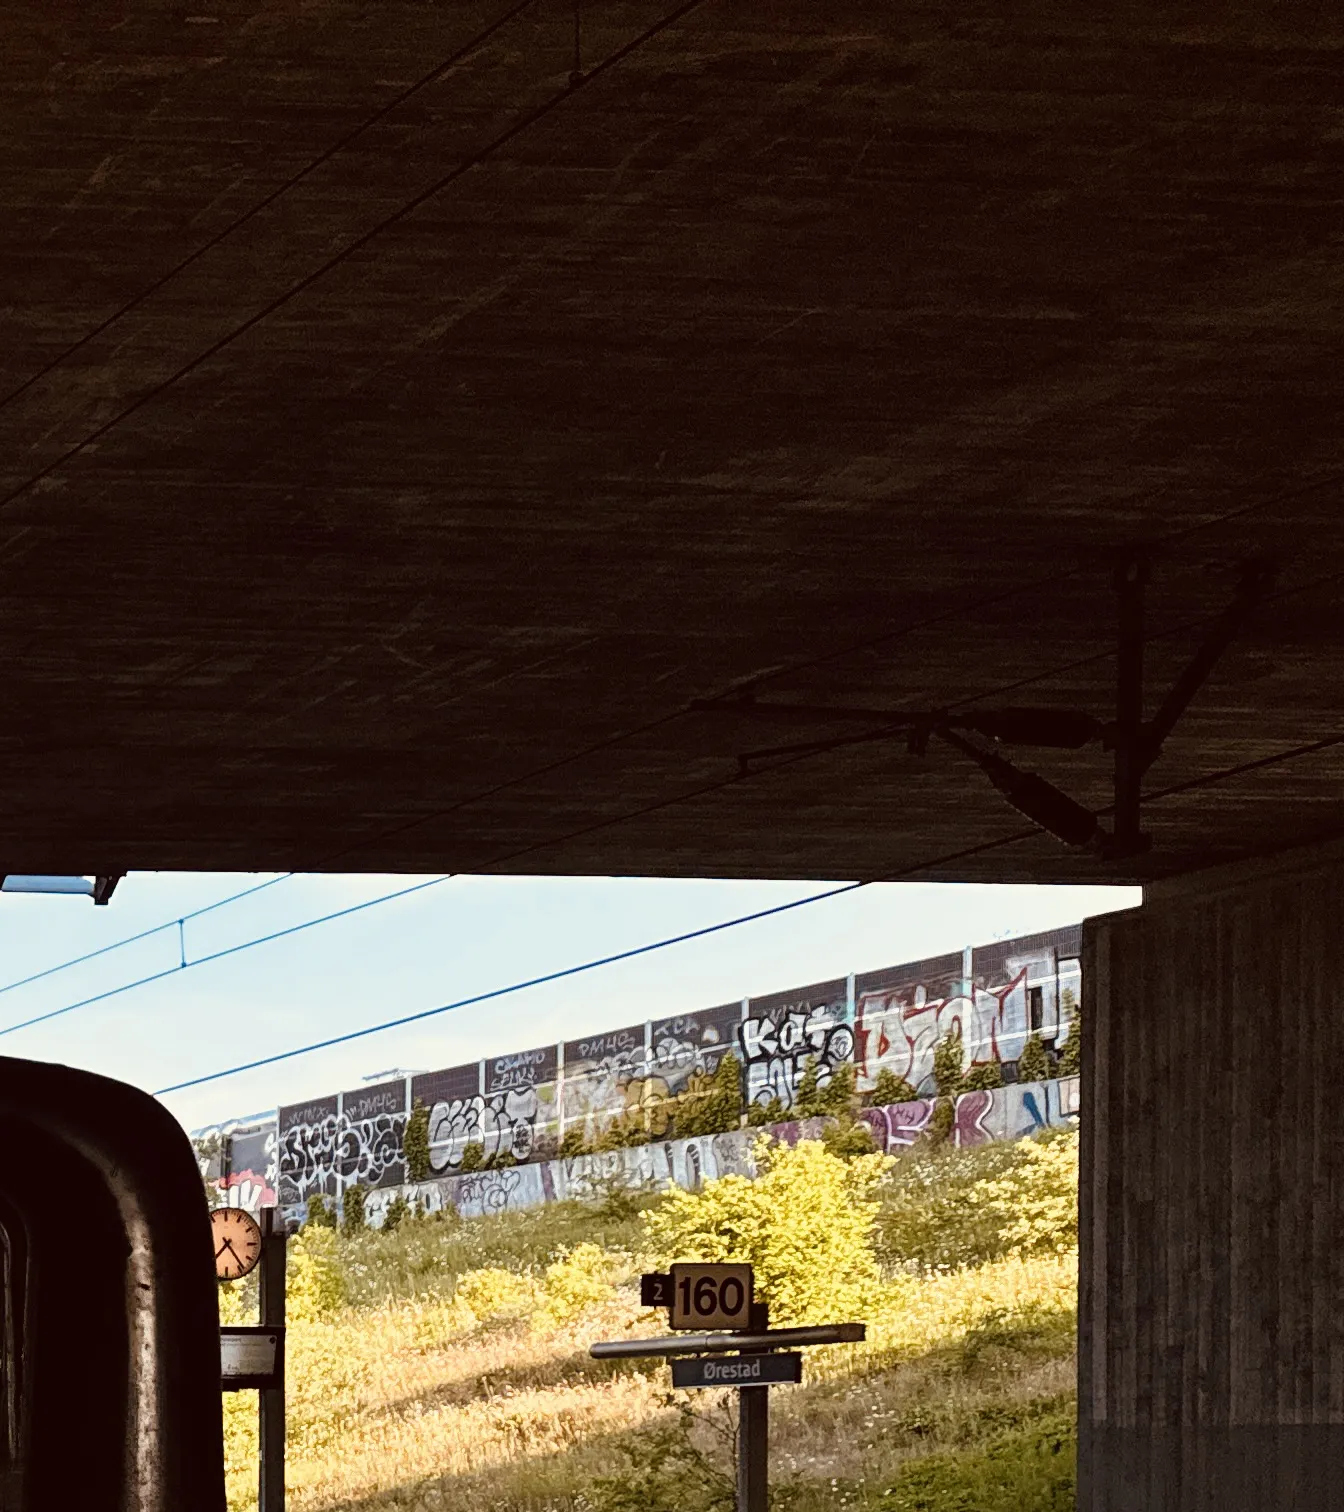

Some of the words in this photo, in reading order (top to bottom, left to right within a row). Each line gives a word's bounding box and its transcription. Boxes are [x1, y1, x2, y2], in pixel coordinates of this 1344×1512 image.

[653, 1283, 664, 1301] 2
[679, 1276, 745, 1317] 160
[703, 1359, 761, 1380] Ørestad
